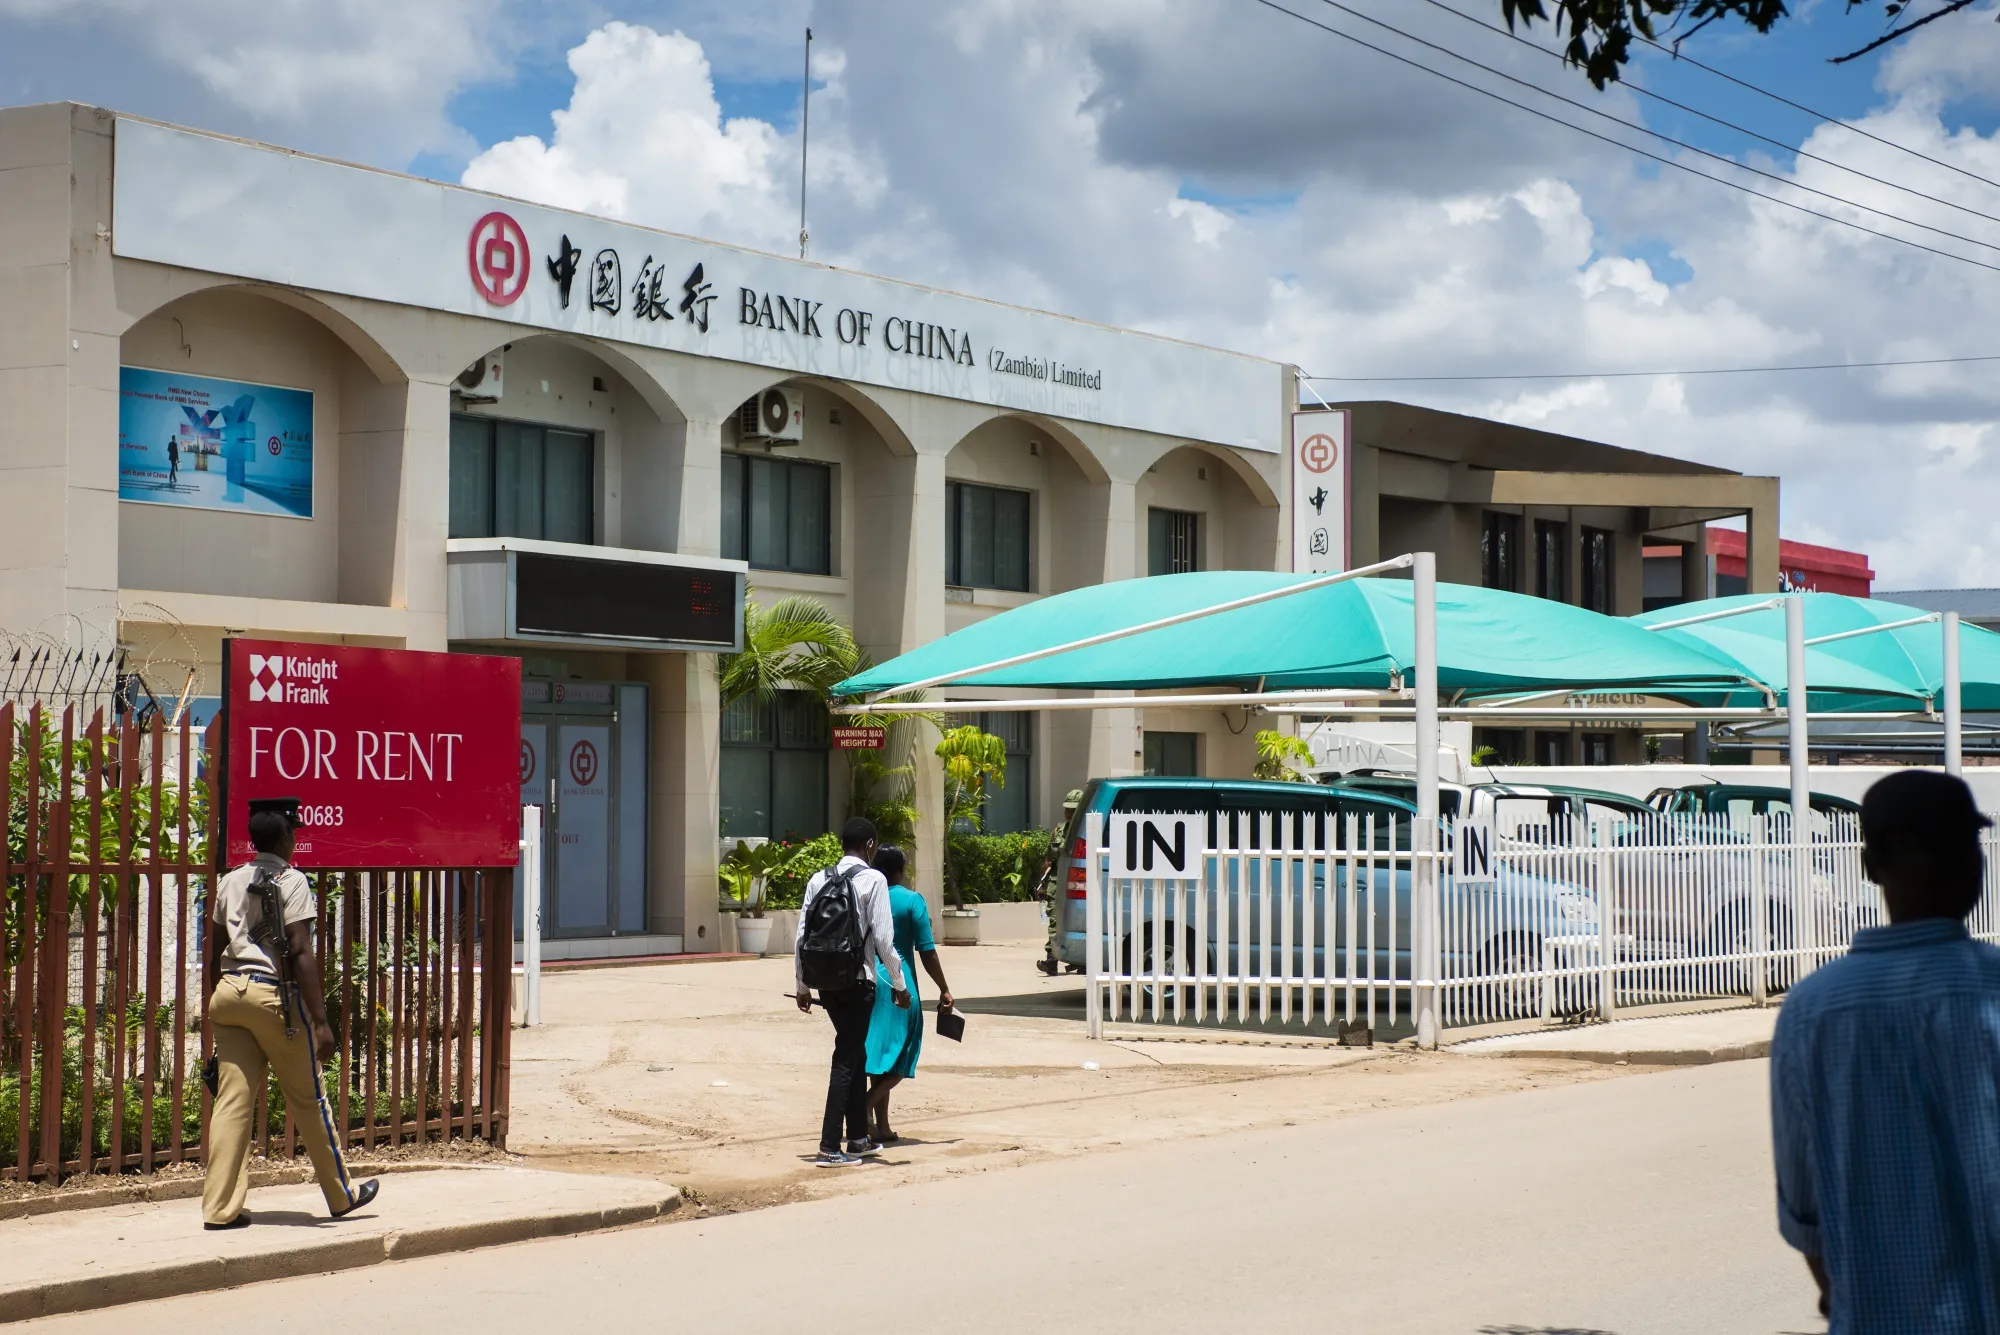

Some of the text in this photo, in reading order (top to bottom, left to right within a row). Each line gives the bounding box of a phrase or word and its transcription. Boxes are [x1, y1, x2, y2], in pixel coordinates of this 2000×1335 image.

[739, 286, 1101, 390] BANK OF CHINA (Zambia) Limited
[193, 390, 210, 398] Choice
[153, 471, 168, 479] China
[1309, 486, 1329, 573] 中國
[286, 656, 338, 684] Knight
[286, 682, 329, 705] Frank
[834, 729, 883, 738] WARNING MAX
[840, 739, 878, 747] HEIGHT 2M
[249, 726, 463, 782] FOR RENT
[561, 833, 580, 844] OUT
[1125, 820, 1186, 872] IN
[1463, 824, 1488, 876] IN
